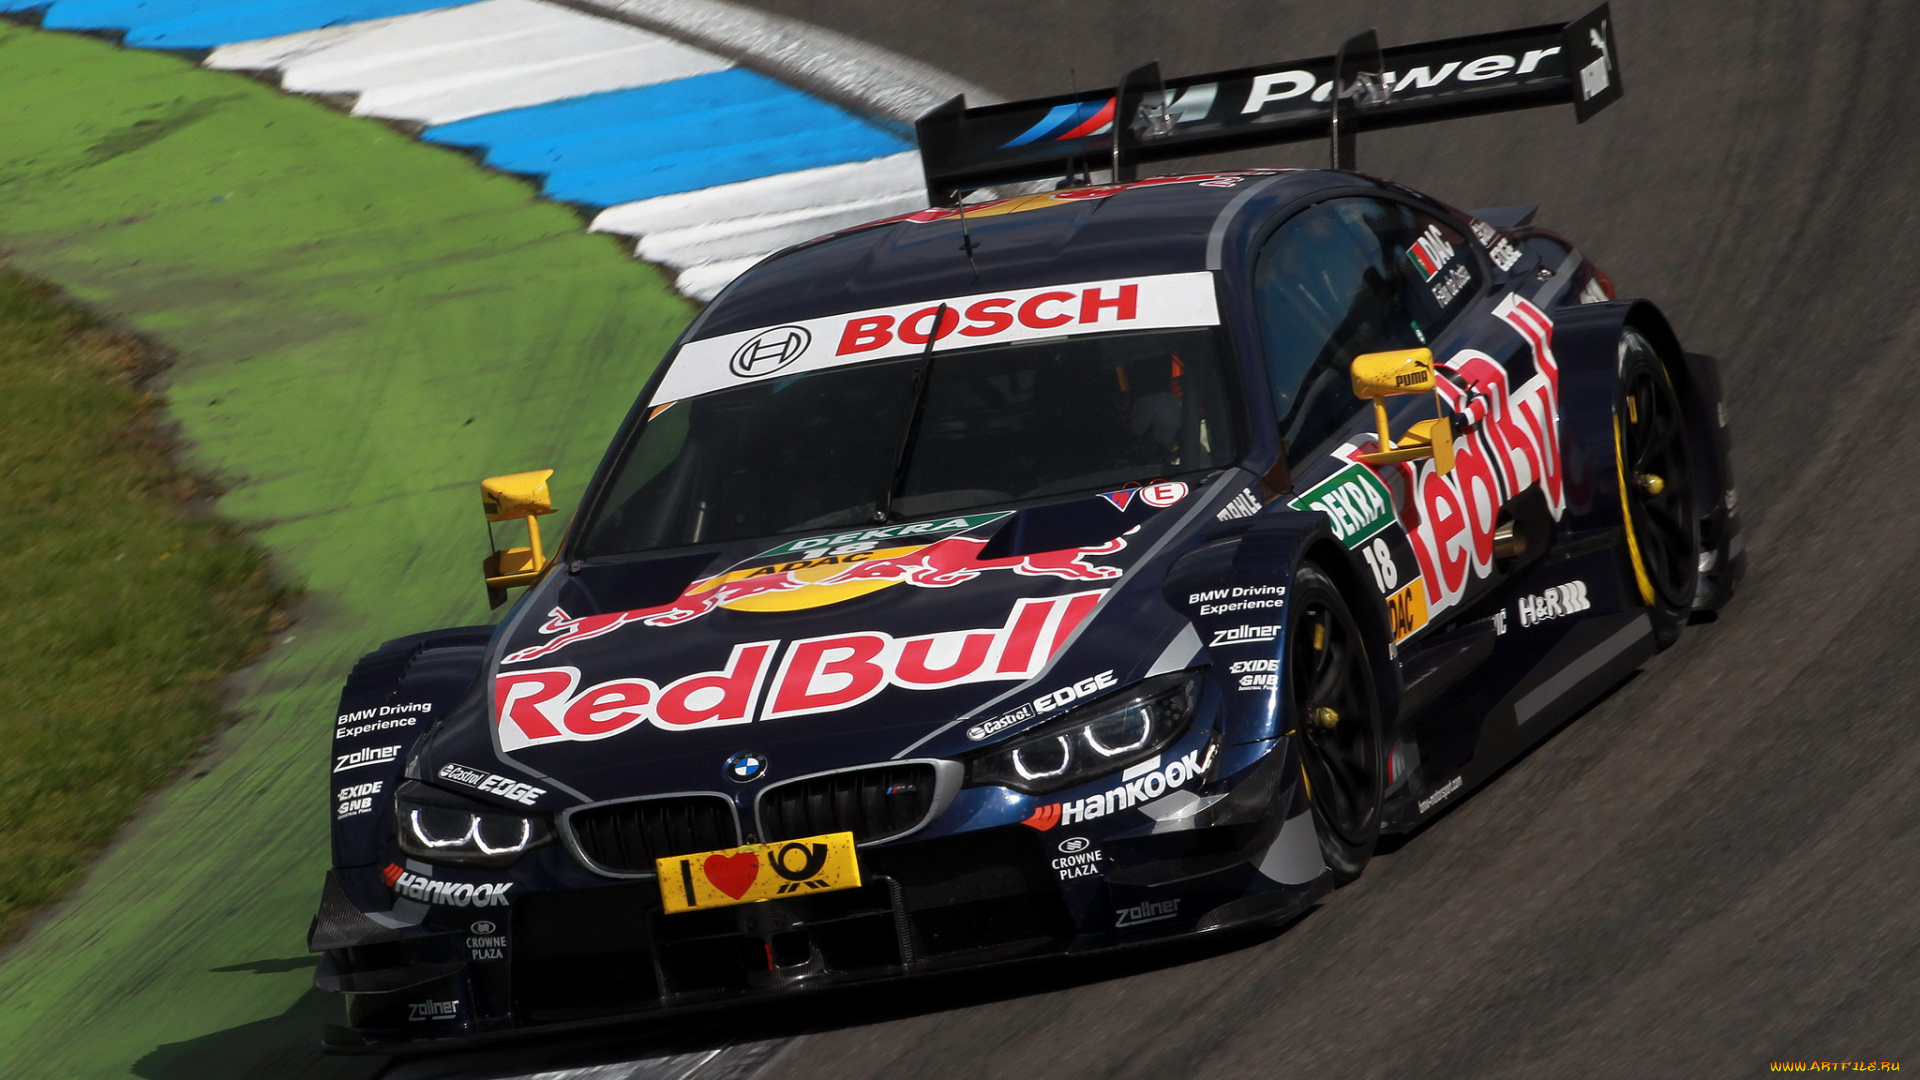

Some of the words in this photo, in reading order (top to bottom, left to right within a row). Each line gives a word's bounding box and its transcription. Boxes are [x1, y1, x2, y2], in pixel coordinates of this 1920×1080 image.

[835, 284, 1138, 357] BOSCH
[1396, 370, 1429, 388] PUMA
[1154, 484, 1174, 501] E
[1309, 474, 1386, 541] DEKRA
[787, 518, 971, 551] DEKRA
[802, 540, 879, 560] 18
[748, 551, 874, 579] ADAC
[1362, 537, 1398, 594] 18
[1188, 588, 1230, 604] BMW
[1232, 585, 1286, 597] Driving
[1200, 599, 1284, 616] Experience
[1518, 588, 1563, 628] H&R
[1208, 624, 1282, 648] Zollner
[496, 643, 772, 741] Red
[763, 592, 1104, 717] Bull
[1230, 659, 1281, 674] EXIDE
[1239, 674, 1279, 686] GNB
[983, 707, 1032, 736] Castrol
[1033, 669, 1119, 713] EDGE
[337, 708, 377, 726] BMW
[379, 702, 432, 716] Driving
[335, 717, 417, 739] Experience
[333, 745, 402, 774] Zollner
[338, 781, 384, 801] EXIDE
[448, 765, 483, 787] Castrol
[477, 774, 548, 806] EDGE
[338, 798, 373, 815] GNB
[1051, 850, 1103, 869] CROWNE
[680, 859, 697, 907] I
[1059, 864, 1099, 881] PLAZA
[466, 935, 507, 949] CROWNE
[472, 948, 504, 960] PLAZA
